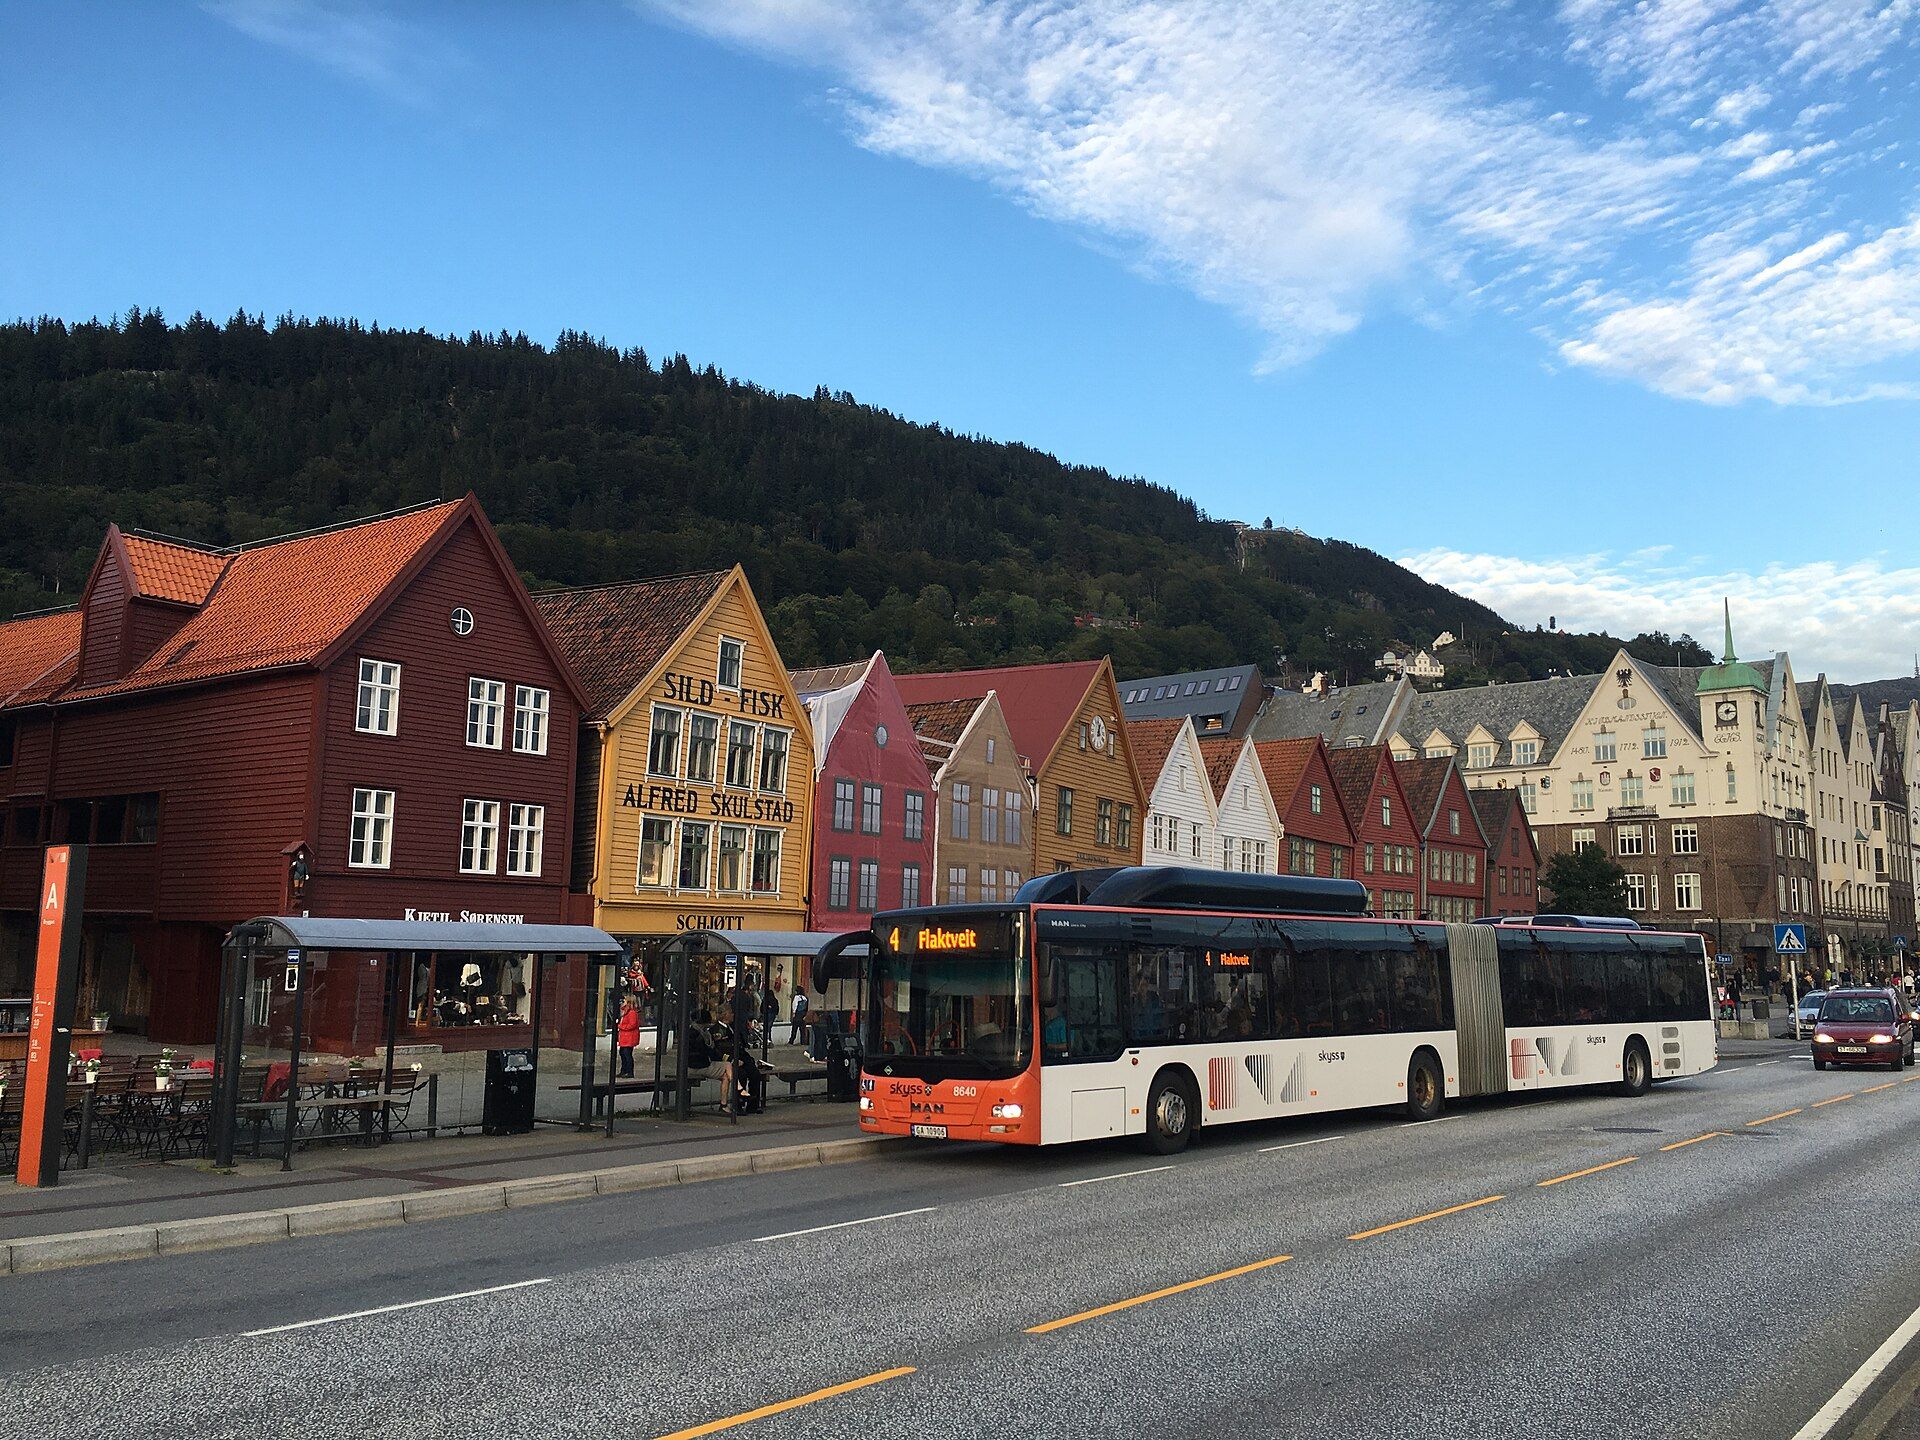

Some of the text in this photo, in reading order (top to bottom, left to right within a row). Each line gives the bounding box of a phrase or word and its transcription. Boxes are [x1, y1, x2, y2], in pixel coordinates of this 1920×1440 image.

[663, 672, 714, 706] SILD
[740, 688, 785, 719] FISK
[623, 783, 794, 823] ALFRED SKULSTAD
[45, 882, 58, 910] A
[676, 914, 745, 931] SCHJØTT
[889, 927, 976, 952] 4 Flaktveit
[1220, 952, 1250, 966] Flaktveit
[727, 970, 735, 985] F
[1586, 1034, 1602, 1046] skyss
[1318, 1049, 1340, 1064] skyss
[889, 1081, 923, 1097] skyss
[953, 1086, 977, 1097] 8640
[911, 1102, 945, 1113] MAN
[915, 1126, 925, 1134] GA
